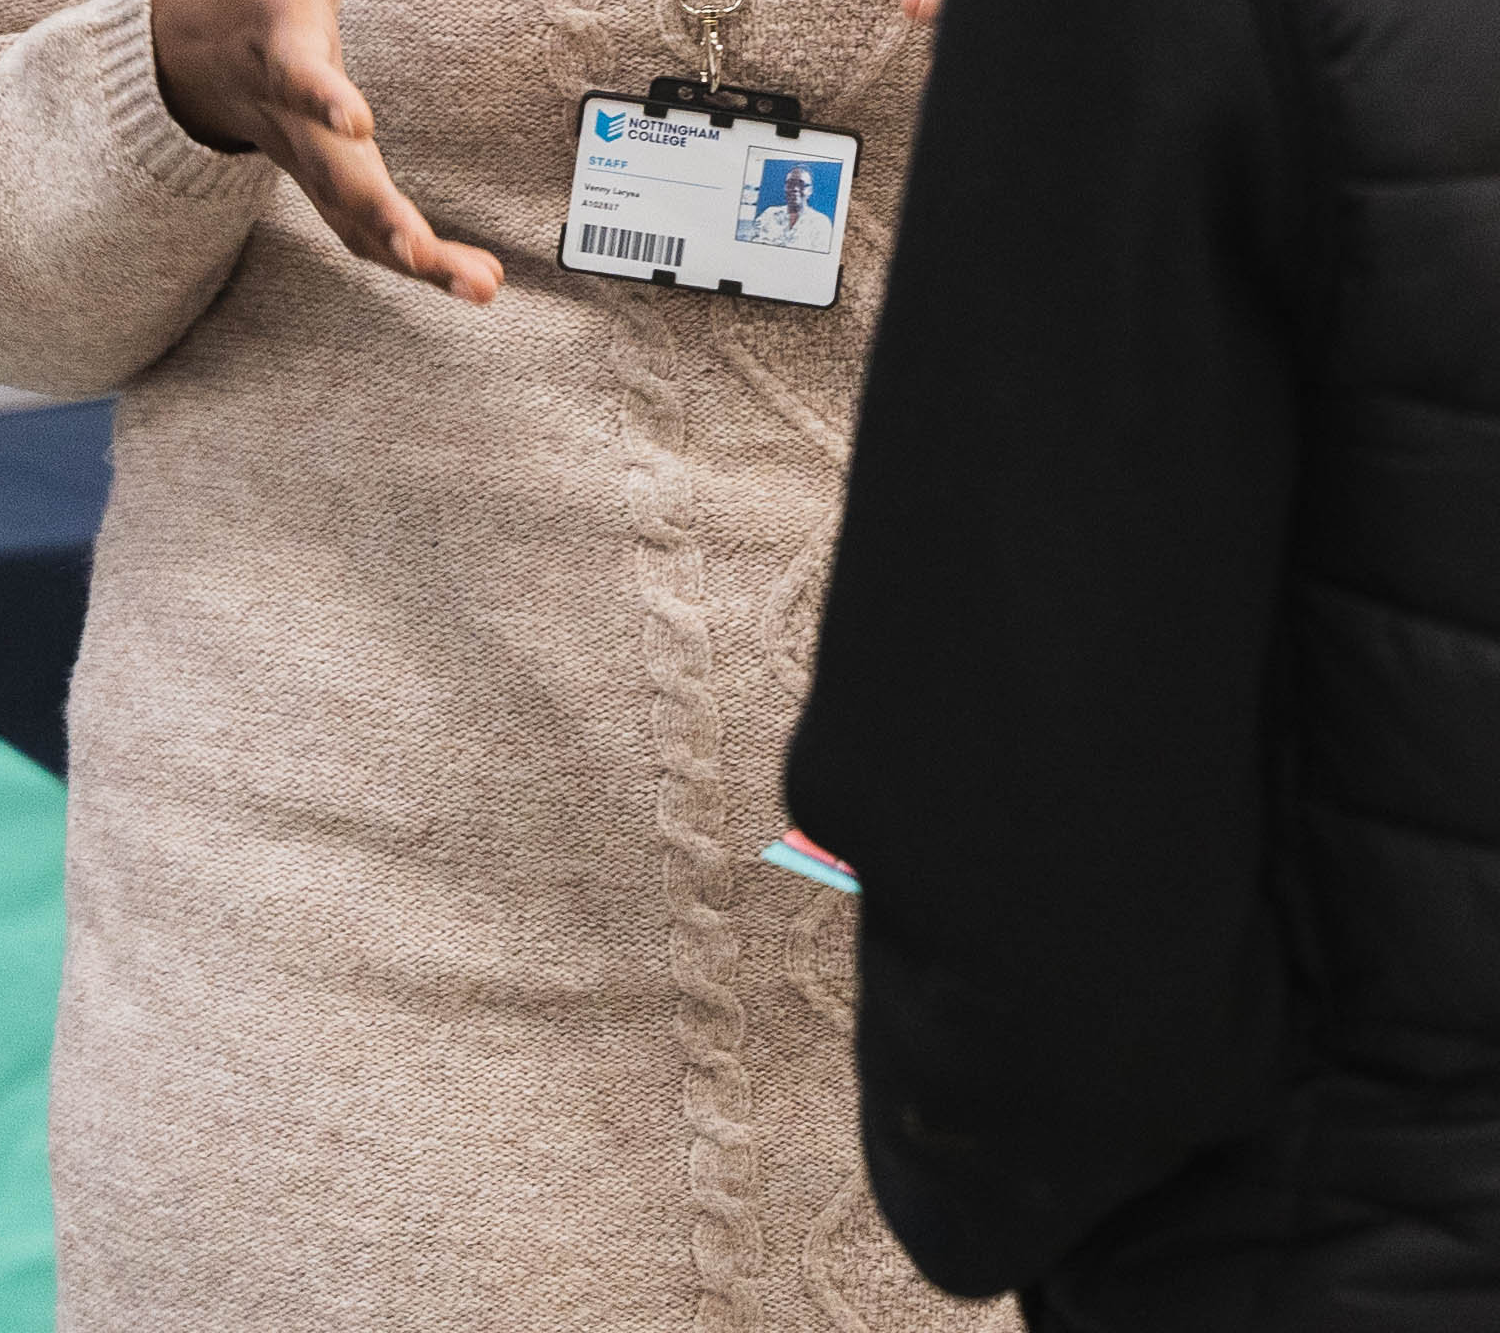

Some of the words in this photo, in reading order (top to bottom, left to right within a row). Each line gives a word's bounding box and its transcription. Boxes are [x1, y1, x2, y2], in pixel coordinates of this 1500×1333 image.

[629, 118, 719, 140] NOTTINGHAM
[628, 130, 687, 147] COLLEGE
[589, 156, 628, 168] STAFF
